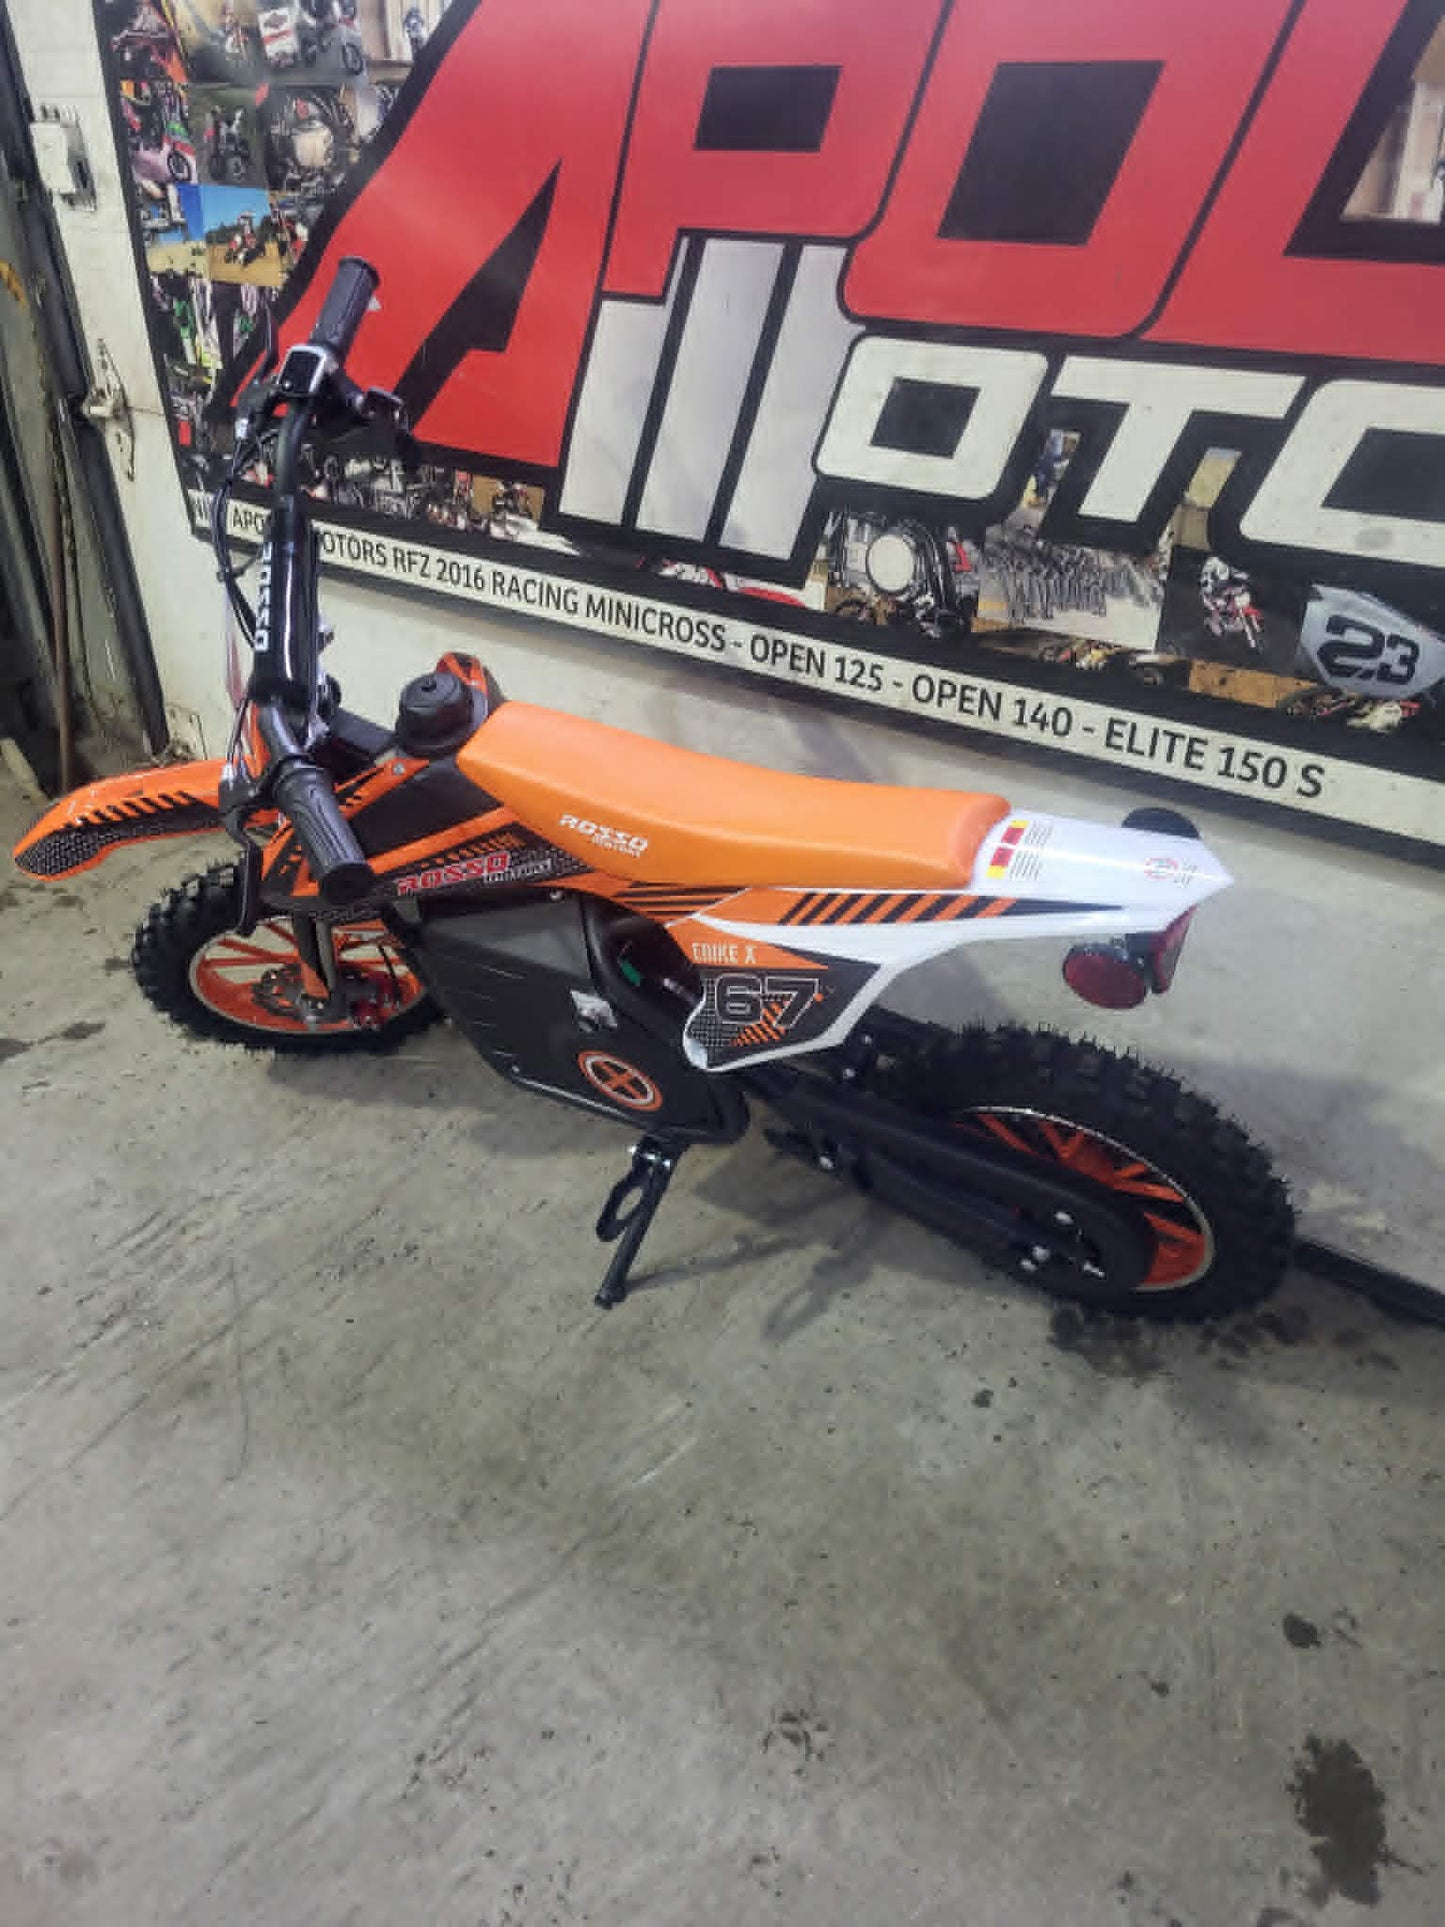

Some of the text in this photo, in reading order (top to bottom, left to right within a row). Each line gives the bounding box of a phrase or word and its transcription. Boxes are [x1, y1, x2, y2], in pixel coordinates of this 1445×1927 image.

[322, 530, 387, 566] OTORS
[393, 547, 431, 578] RFZ
[436, 558, 486, 591] 2016
[492, 571, 579, 616] RACING
[586, 594, 727, 652] MINICROSS
[750, 634, 825, 678] OPEN
[835, 656, 883, 692] 125
[912, 674, 1003, 721] OPEN
[1014, 699, 1073, 737] 140
[1105, 717, 1209, 771] ELITE
[1217, 746, 1288, 789] 150
[1298, 764, 1325, 798] S
[395, 851, 510, 896] ROSSO
[714, 972, 820, 1029] 67
